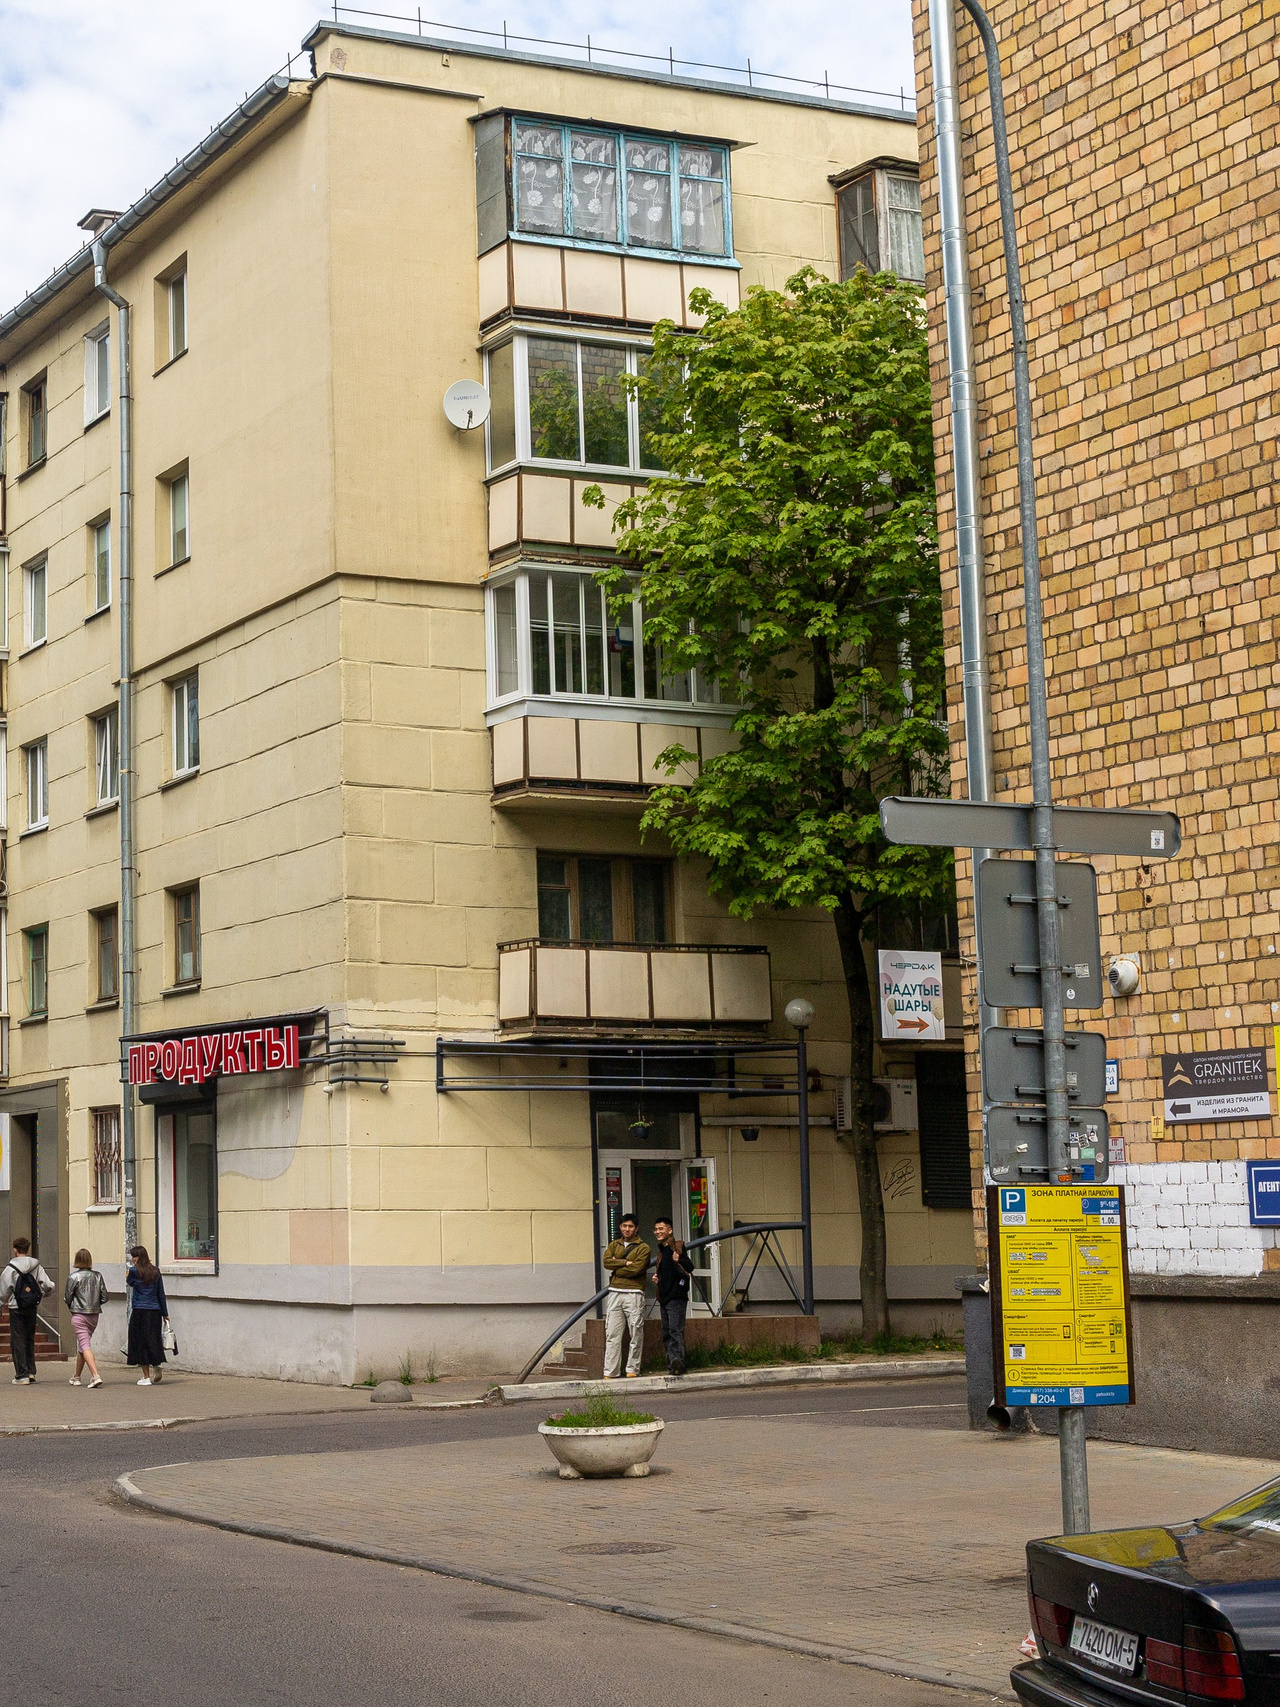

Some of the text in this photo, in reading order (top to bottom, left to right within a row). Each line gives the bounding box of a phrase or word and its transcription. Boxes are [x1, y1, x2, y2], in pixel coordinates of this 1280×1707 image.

[884, 983, 939, 997] НАДУТЫЕ
[894, 999, 931, 1012] ШАРЫ
[128, 1025, 299, 1085] ПРОДУКТЫ
[1194, 1059, 1262, 1078] GRANITEK
[1195, 1074, 1263, 1085] твердое качество
[1197, 1098, 1225, 1106] ИЗДЕЛИЯ
[1235, 1095, 1264, 1103] ГРАНИТА
[1218, 1106, 1249, 1115] МРАМОРА
[1055, 1188, 1087, 1197] ПЛАТНАЙ
[1088, 1188, 1114, 1197] ПАРКОЎКІ
[1006, 1191, 1021, 1210] P
[1038, 1394, 1056, 1404] 204
